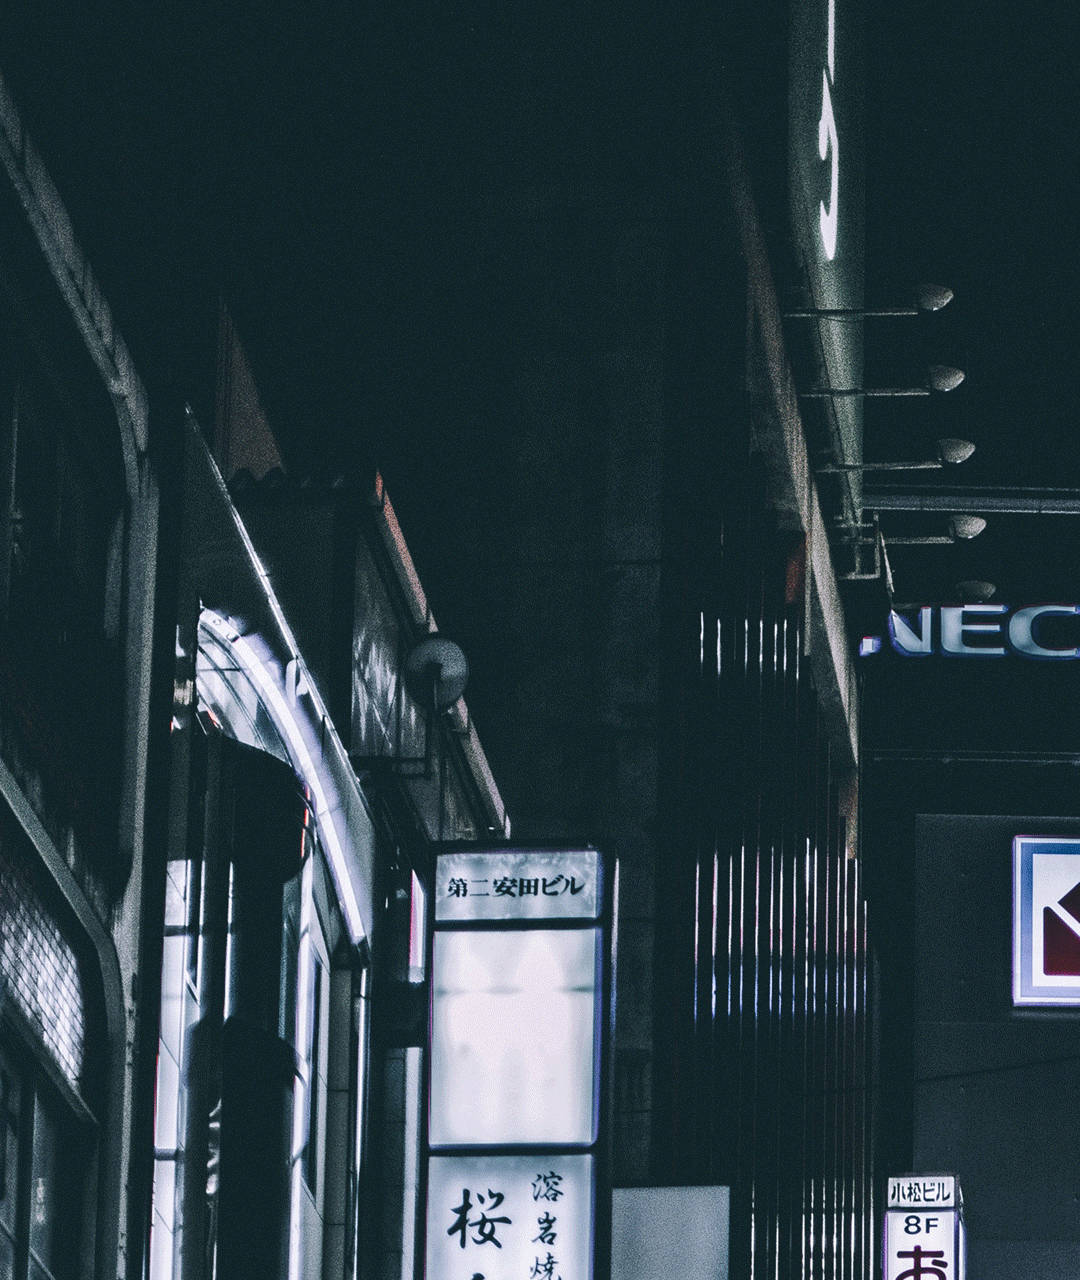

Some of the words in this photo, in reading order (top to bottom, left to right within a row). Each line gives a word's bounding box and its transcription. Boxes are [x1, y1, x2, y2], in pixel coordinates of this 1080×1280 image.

[446, 872, 586, 899] 第二安田ビル
[890, 1182, 951, 1203] 小松ビル
[903, 1215, 939, 1235] 8F
